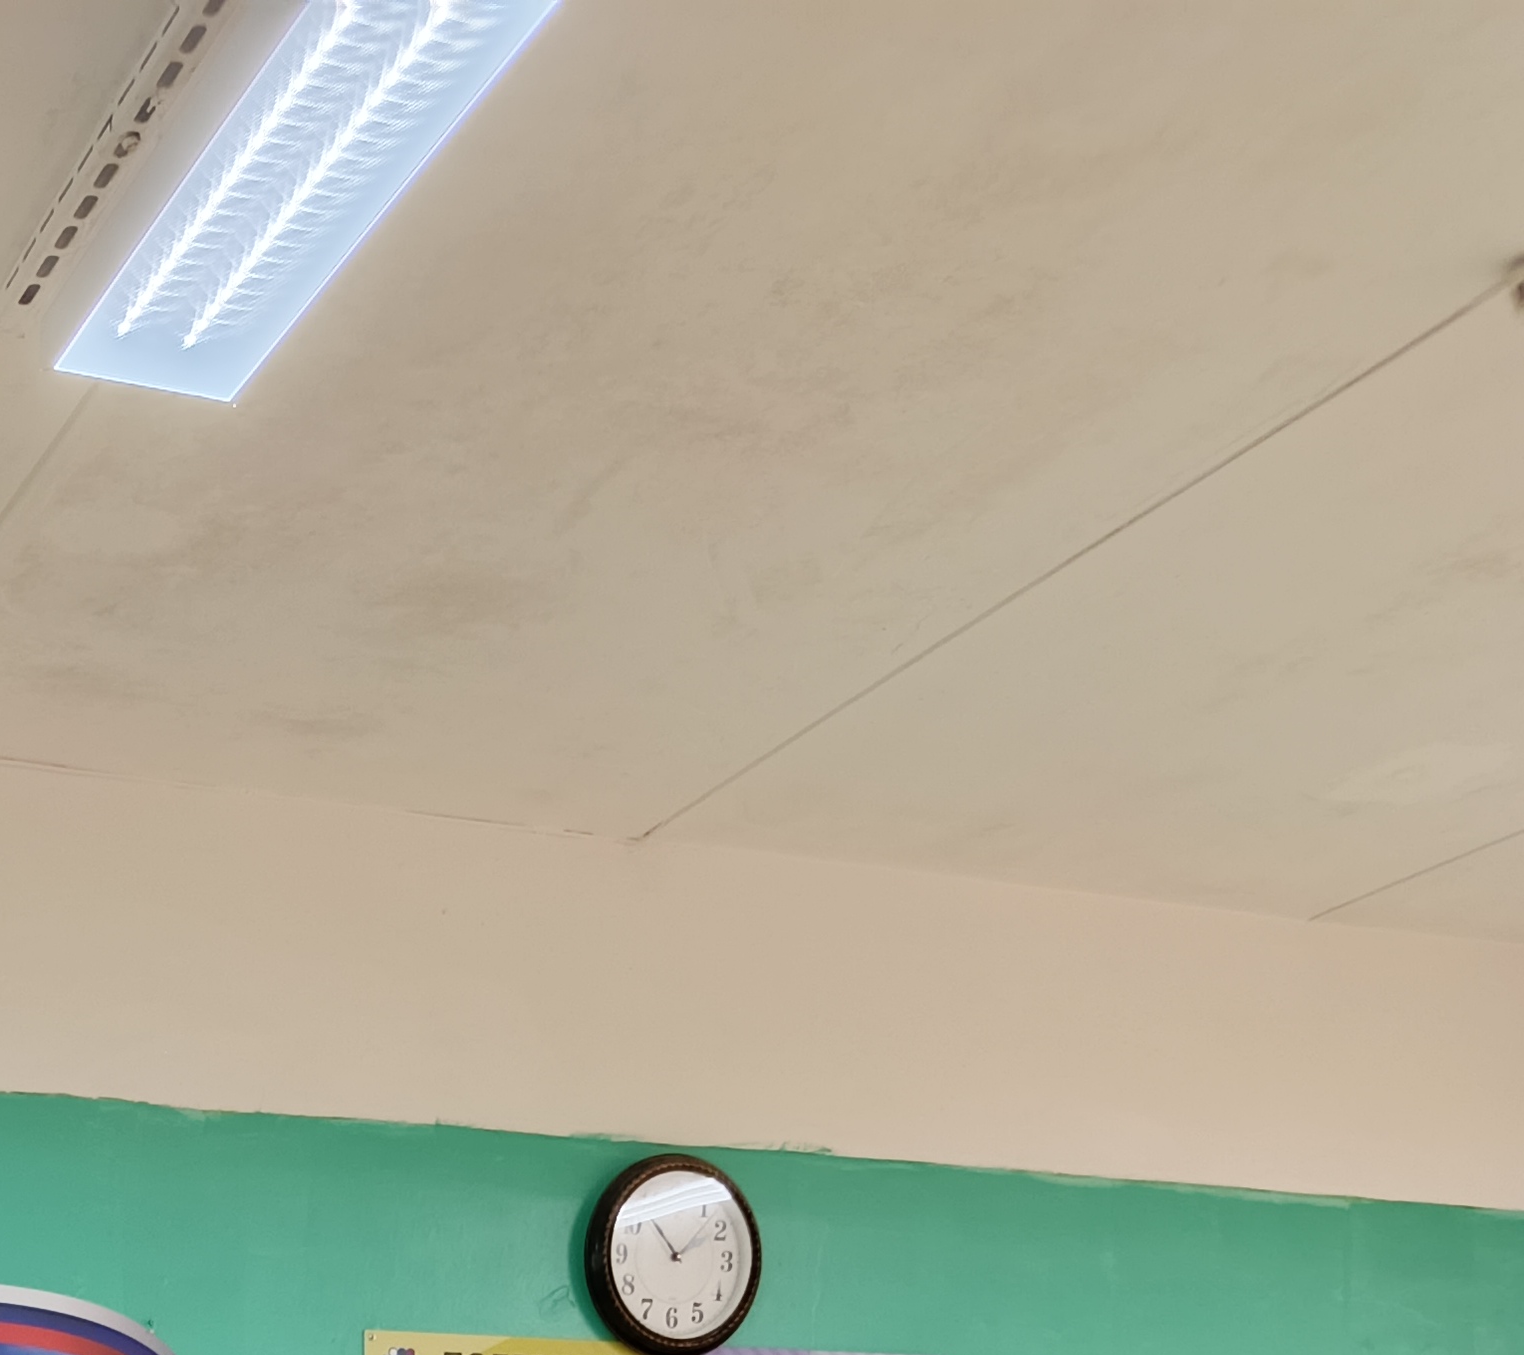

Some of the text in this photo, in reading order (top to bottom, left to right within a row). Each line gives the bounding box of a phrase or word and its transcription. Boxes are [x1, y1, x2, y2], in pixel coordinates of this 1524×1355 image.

[713, 1220, 727, 1241] 2
[616, 1243, 628, 1265] 9
[720, 1251, 733, 1272] 3
[621, 1274, 635, 1296] 8
[641, 1298, 653, 1320] 7
[666, 1307, 678, 1329] 6
[691, 1302, 704, 1324] 5
